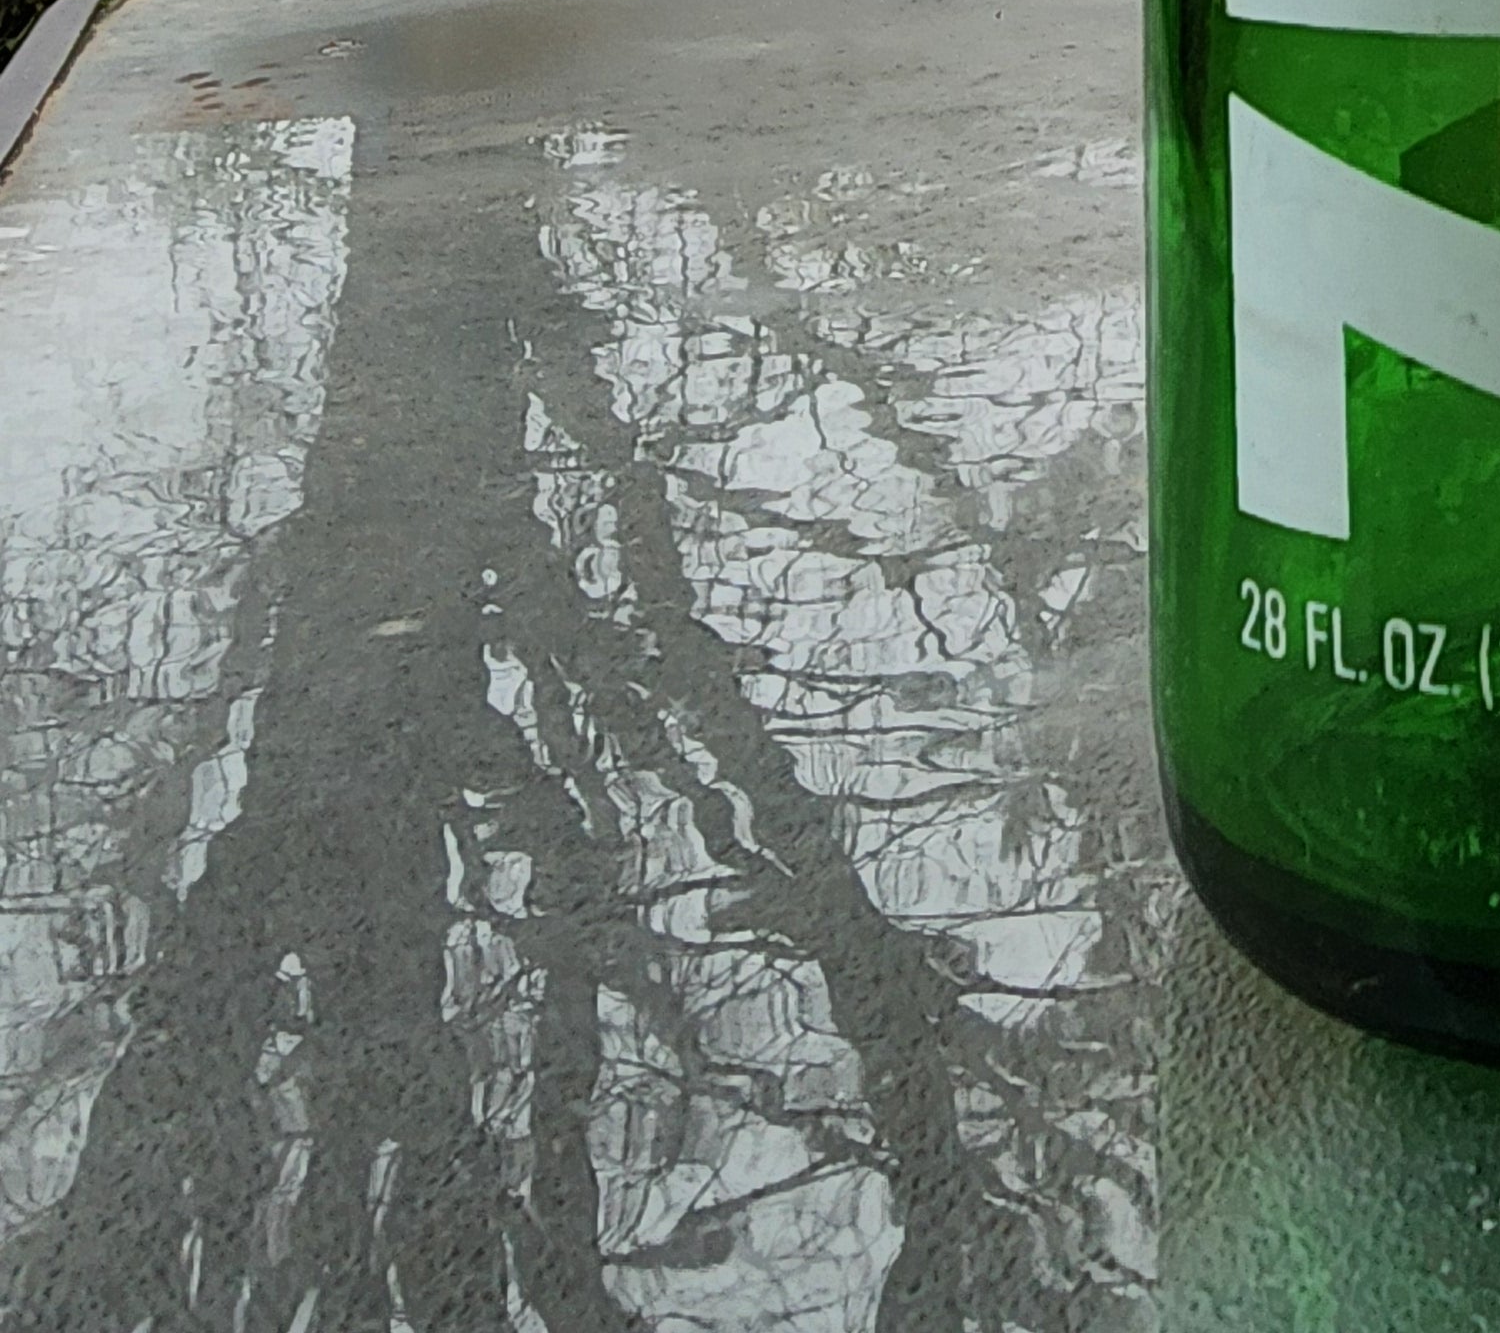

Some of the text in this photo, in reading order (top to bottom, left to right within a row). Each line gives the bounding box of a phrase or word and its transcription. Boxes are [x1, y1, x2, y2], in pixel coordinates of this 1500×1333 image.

[1241, 578, 1287, 659] 28
[1305, 600, 1368, 682] FL.
[1384, 617, 1462, 697] OZ.
